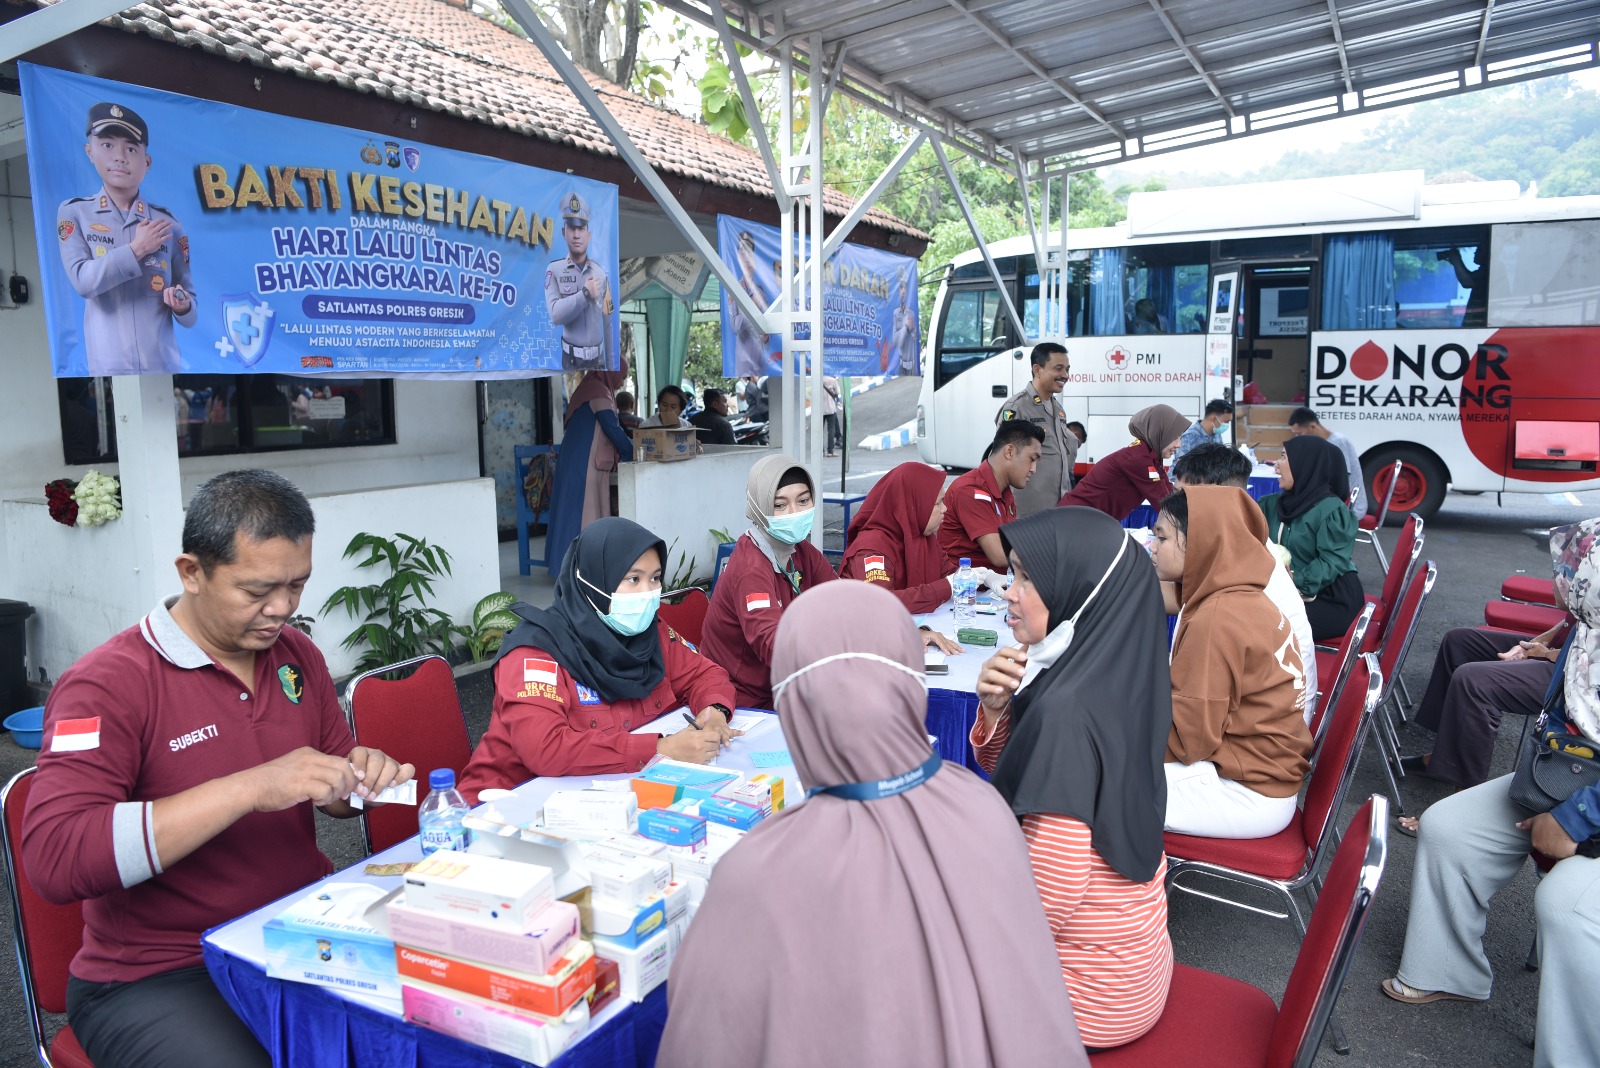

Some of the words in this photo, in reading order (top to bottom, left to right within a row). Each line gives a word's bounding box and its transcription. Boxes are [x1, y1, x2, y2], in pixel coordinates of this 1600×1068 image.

[198, 163, 341, 209] BAKTI
[351, 172, 554, 249] KESEHATAN
[350, 216, 390, 229] DALAM
[393, 218, 437, 238] RANGKA
[87, 234, 114, 245] ROVAN
[272, 227, 348, 259] HARI
[353, 228, 415, 261] LALU
[421, 236, 501, 277] LINTAS
[255, 262, 454, 295] BHAYANGKARA
[458, 273, 517, 307] KE-70
[839, 263, 890, 301] DARAH
[318, 301, 383, 316] SATLANTAS
[386, 303, 427, 317] POLRES
[429, 304, 464, 319] GRESIK
[845, 301, 876, 321] LINTAS
[316, 324, 352, 335] LINTAS
[354, 326, 394, 336] MODERN
[398, 327, 421, 337] YANG
[423, 327, 496, 338] BERKESELAMATAN
[859, 321, 882, 340] KE-70
[309, 336, 352, 347] MENUJU
[354, 338, 401, 347] ASTACITA
[402, 338, 451, 348] INDONESIA
[1136, 353, 1162, 365] PMI
[1316, 340, 1512, 381] DONOR
[1067, 373, 1097, 383] MOBIL
[1099, 373, 1122, 383] UNIT
[1125, 373, 1162, 383] DONOR
[1164, 372, 1202, 382] DARAH
[1315, 385, 1512, 409] SEKARANG
[1315, 411, 1356, 421] SETETES
[1359, 412, 1393, 421] DARAH
[1395, 412, 1425, 422] ANDA,
[1428, 412, 1463, 422] NYAWA
[1466, 413, 1510, 422] MEREKA
[866, 569, 887, 578] URKES
[517, 689, 541, 698] POLRES
[543, 691, 565, 704] GRESIK
[524, 681, 557, 694] URKES
[169, 724, 219, 752] SUBEKTI
[423, 831, 452, 844] AQUA
[304, 971, 334, 983] SATLANTAS
[357, 979, 378, 990] GRESIK
